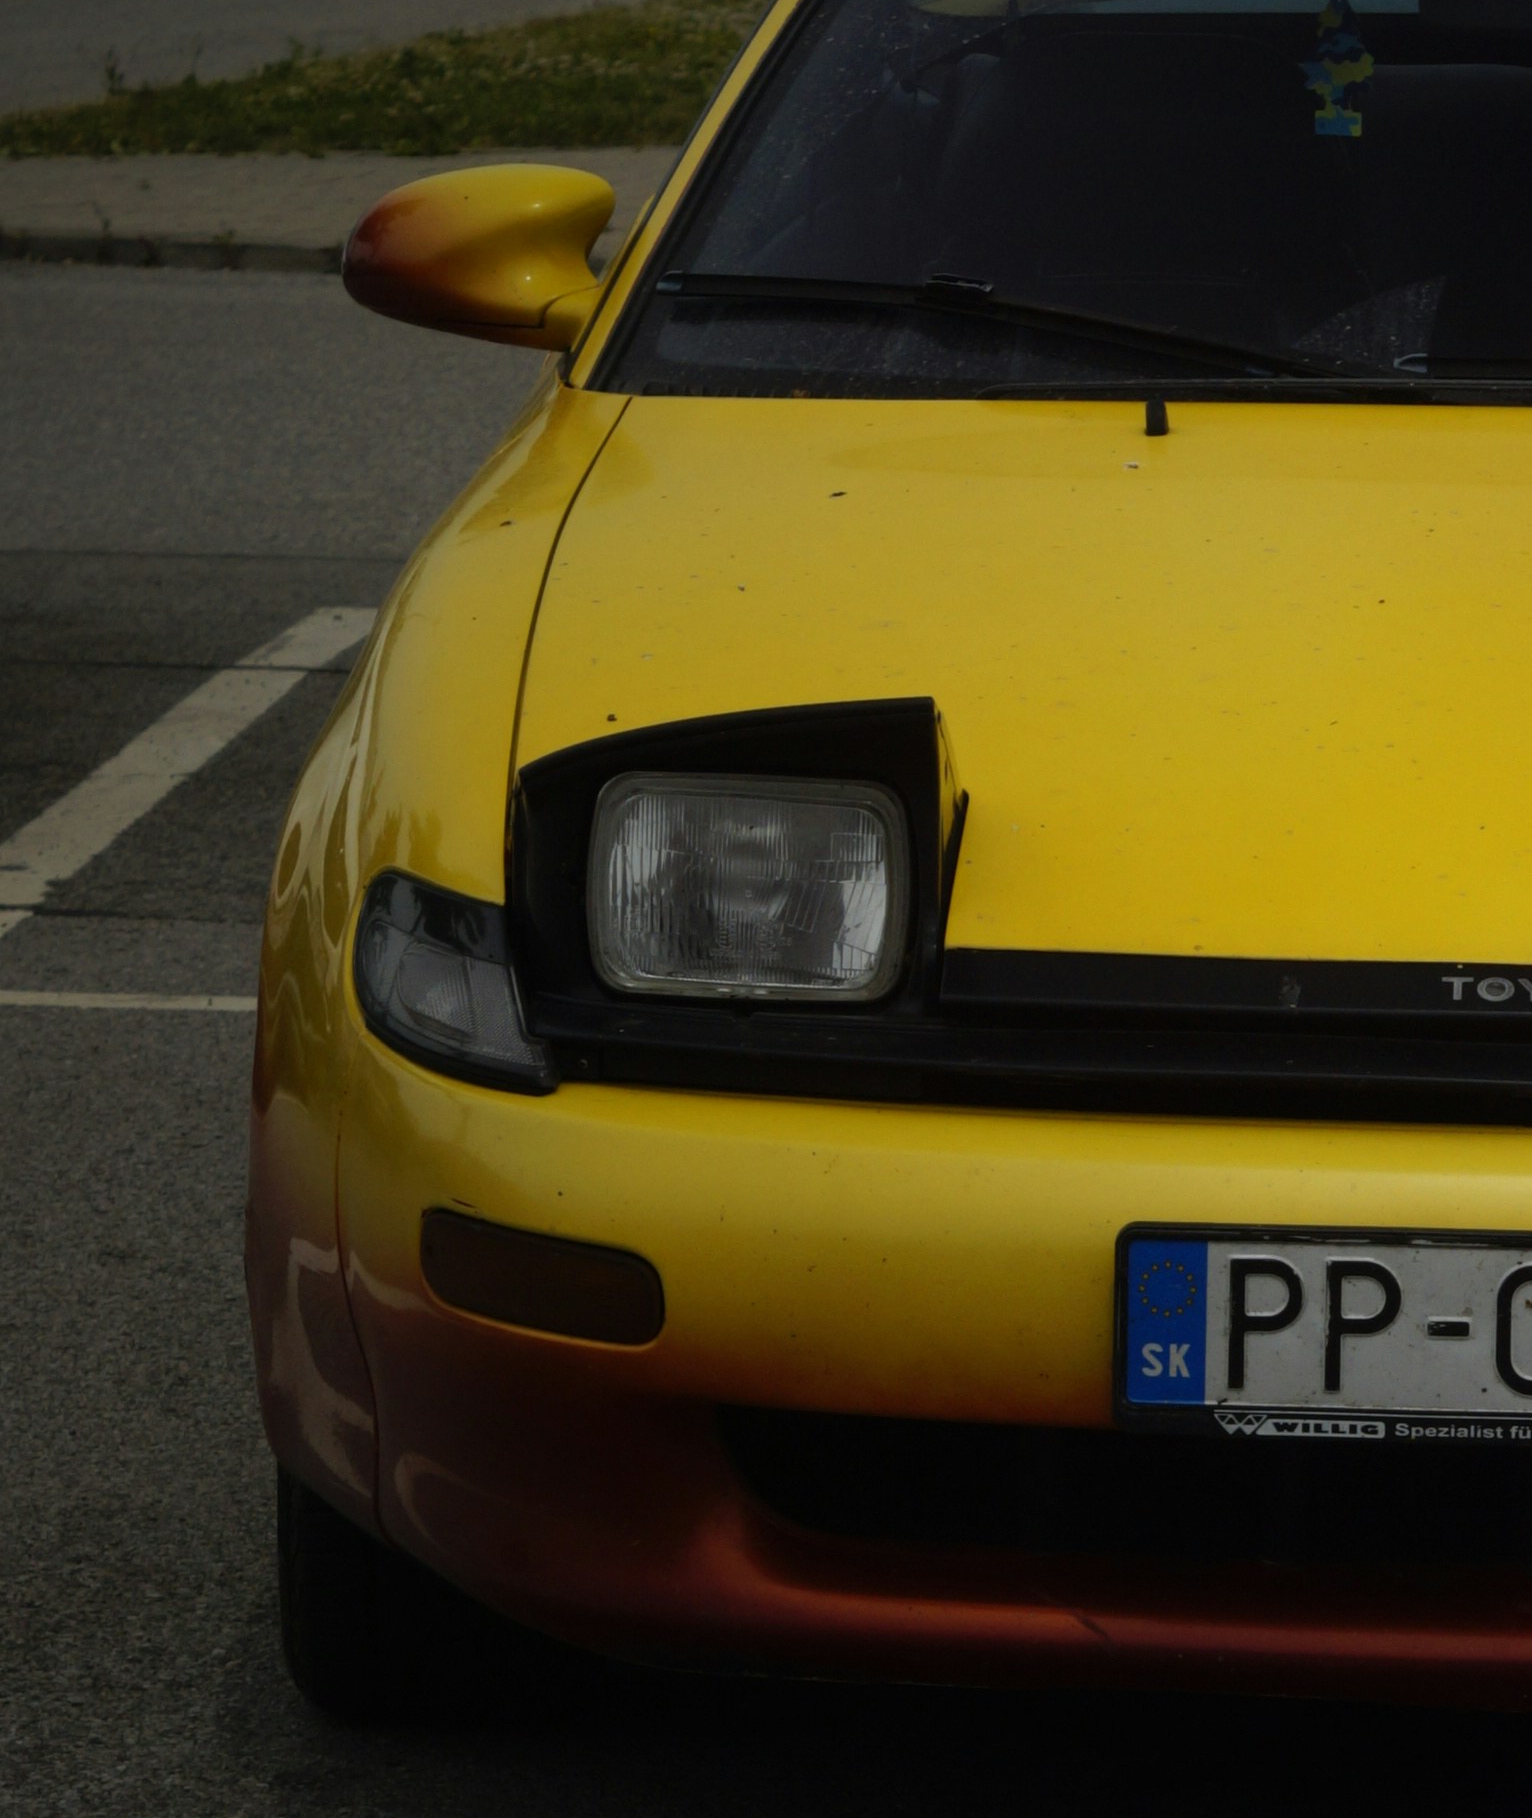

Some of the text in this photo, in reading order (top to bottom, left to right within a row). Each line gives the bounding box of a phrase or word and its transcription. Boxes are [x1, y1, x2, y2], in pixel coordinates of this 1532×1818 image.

[1140, 1342, 1192, 1379] SK
[1272, 1421, 1381, 1437] WILLIG
[1393, 1422, 1504, 1441] Spezialist
